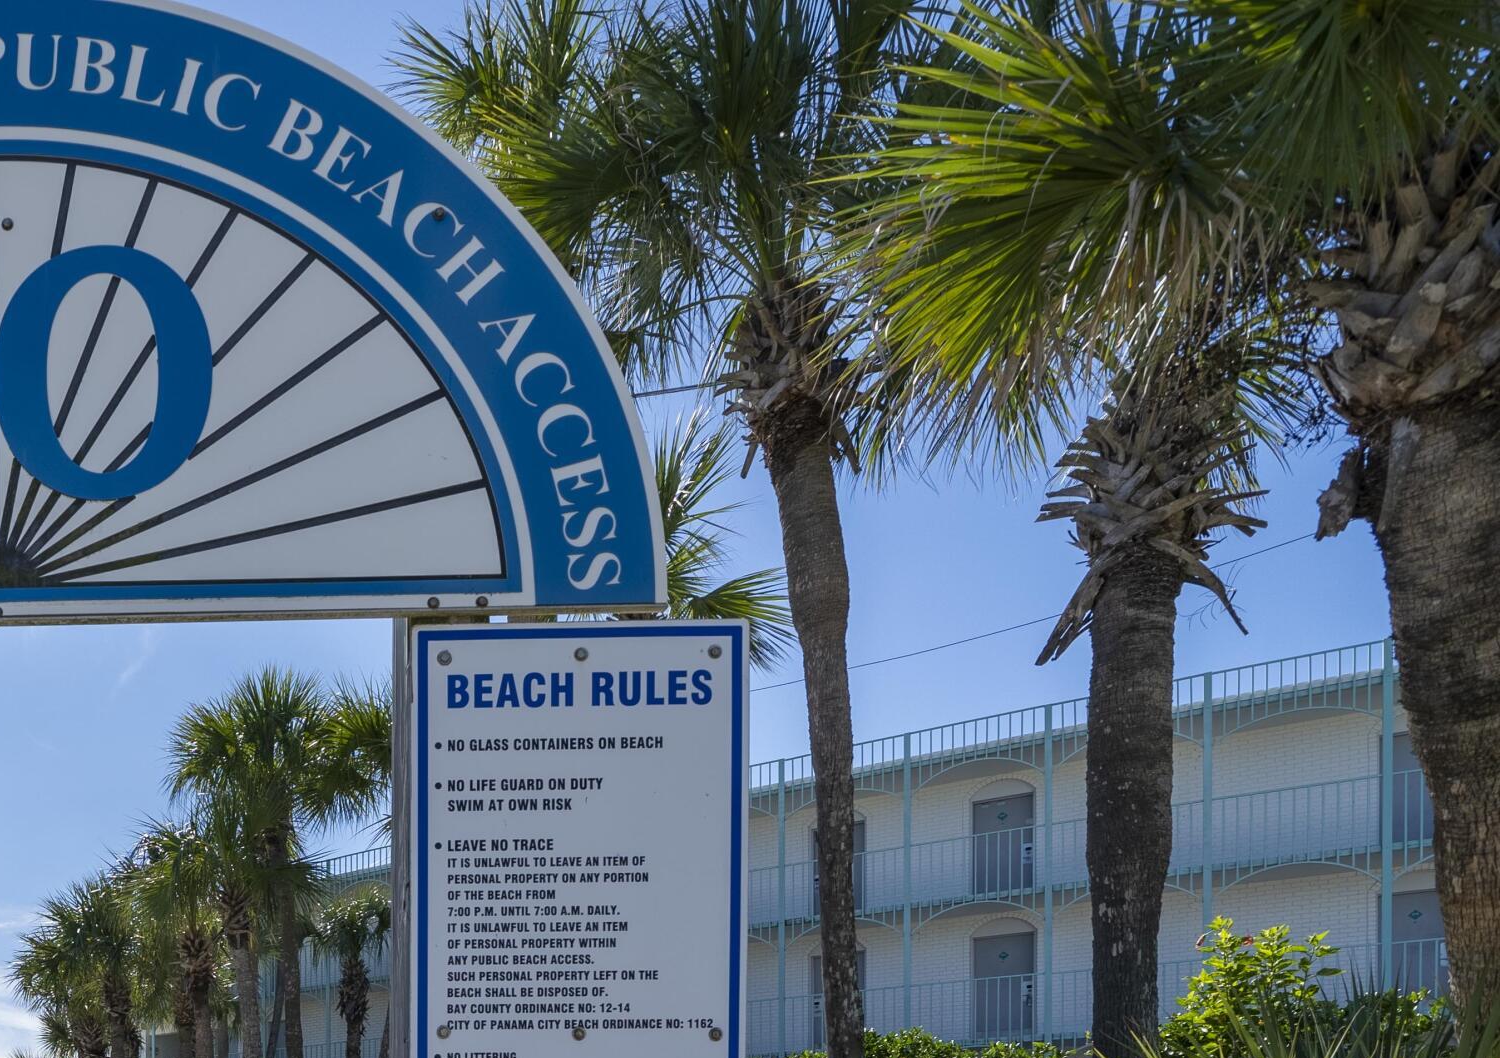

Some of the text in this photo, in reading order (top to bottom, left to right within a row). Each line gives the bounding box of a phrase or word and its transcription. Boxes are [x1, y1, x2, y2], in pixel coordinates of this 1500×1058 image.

[267, 98, 505, 305] BEACH
[478, 312, 620, 590] ACCESS
[447, 669, 712, 708] BEACH RULES
[447, 736, 663, 751] NO GLASS CONTAINERS ON BEACH
[447, 777, 603, 791] NO LIFE GUARD ON DUTY
[447, 798, 572, 811] SWIM AT OWN RISK
[447, 838, 553, 851] LEAVE NO TRACE
[447, 855, 645, 868] IT IS UNLAWFUL TO LEAVE AN ITEM OF
[447, 872, 649, 884] PERSONAL PROPERTY ON ANY PORTION
[447, 905, 620, 916] 7:00 P.M. UNTIL 7:00 A.M. DAILY.
[447, 954, 594, 965] ANY PUBLIC BEACH ACCESS.
